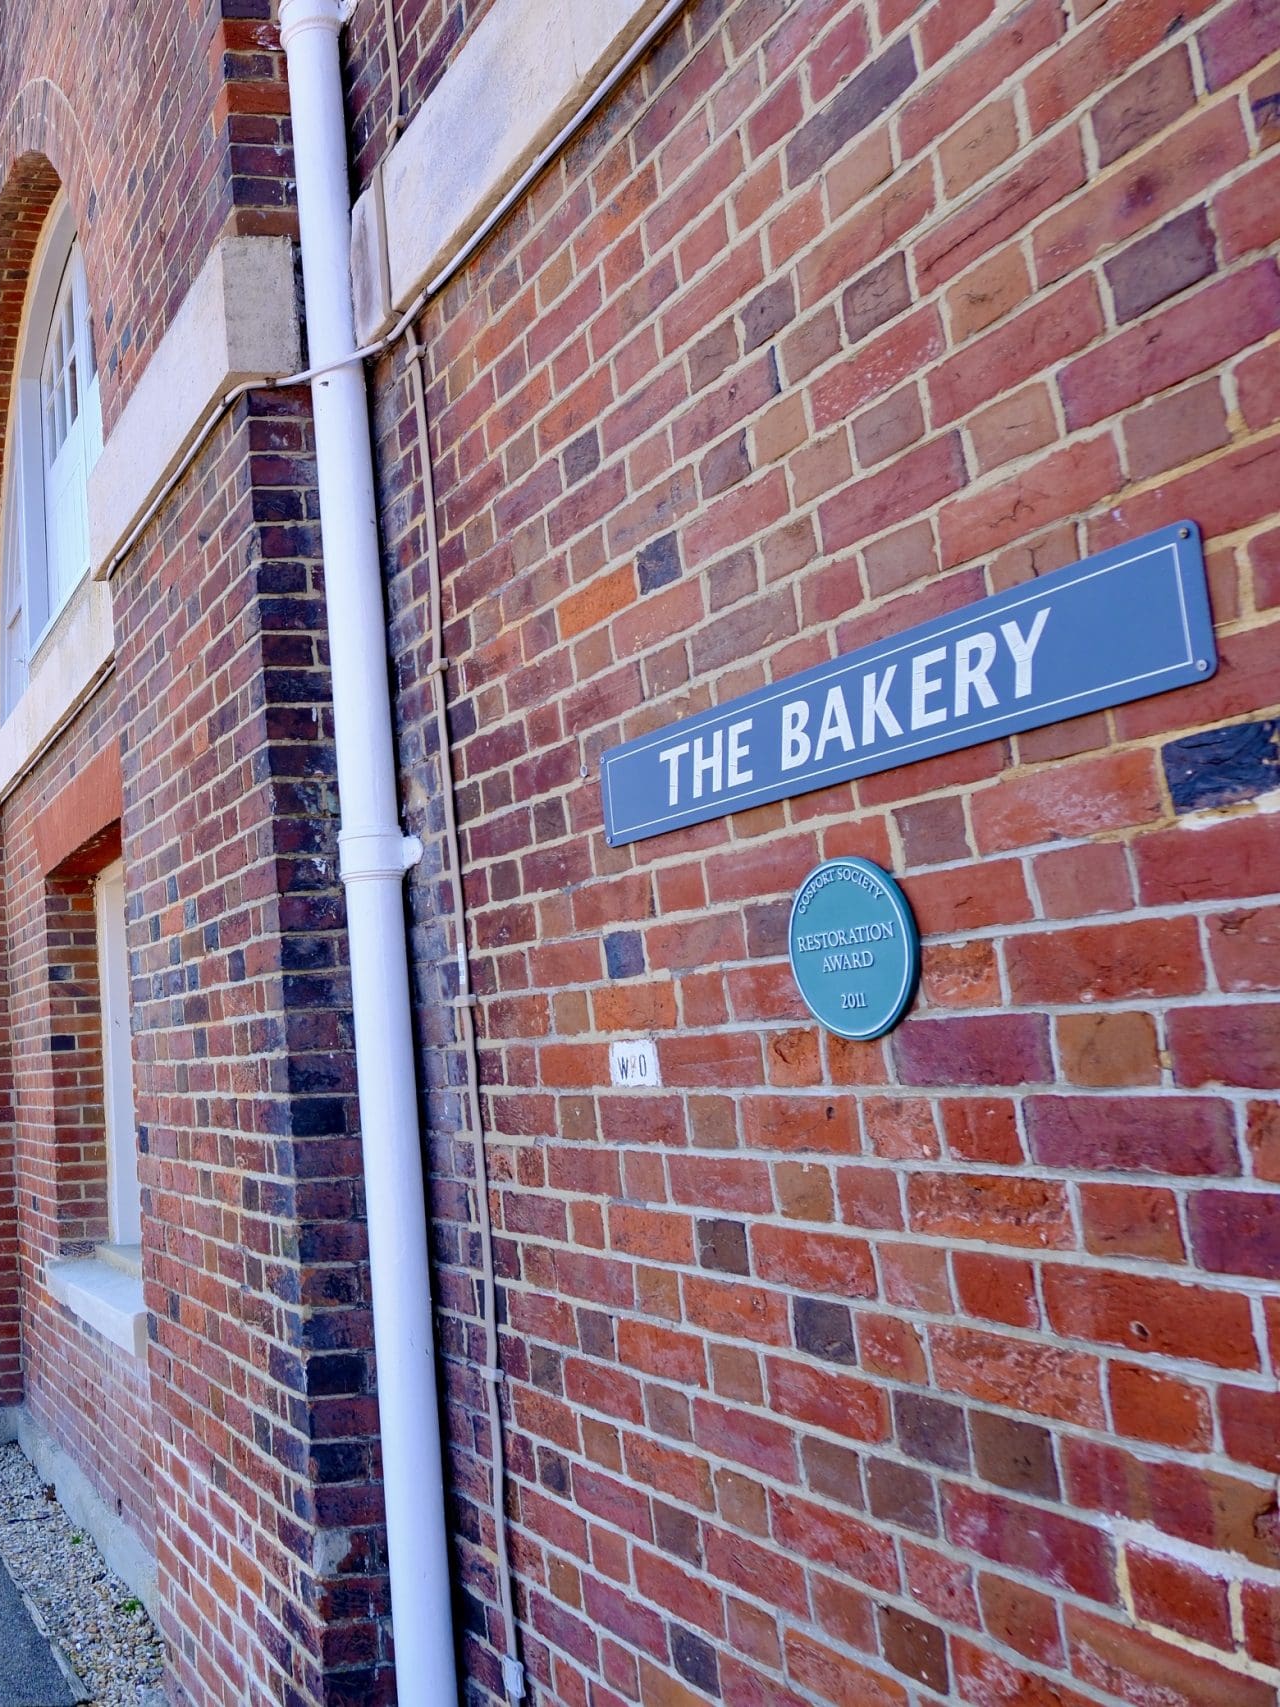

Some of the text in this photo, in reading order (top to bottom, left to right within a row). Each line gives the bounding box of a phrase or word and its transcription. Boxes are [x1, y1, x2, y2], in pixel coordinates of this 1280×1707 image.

[659, 607, 1053, 806] THE BAKERY
[797, 867, 885, 915] GOSPORT SOCIETY
[796, 920, 895, 953] RESTORATION
[822, 950, 874, 973] AWARD
[840, 992, 868, 1009] 2011
